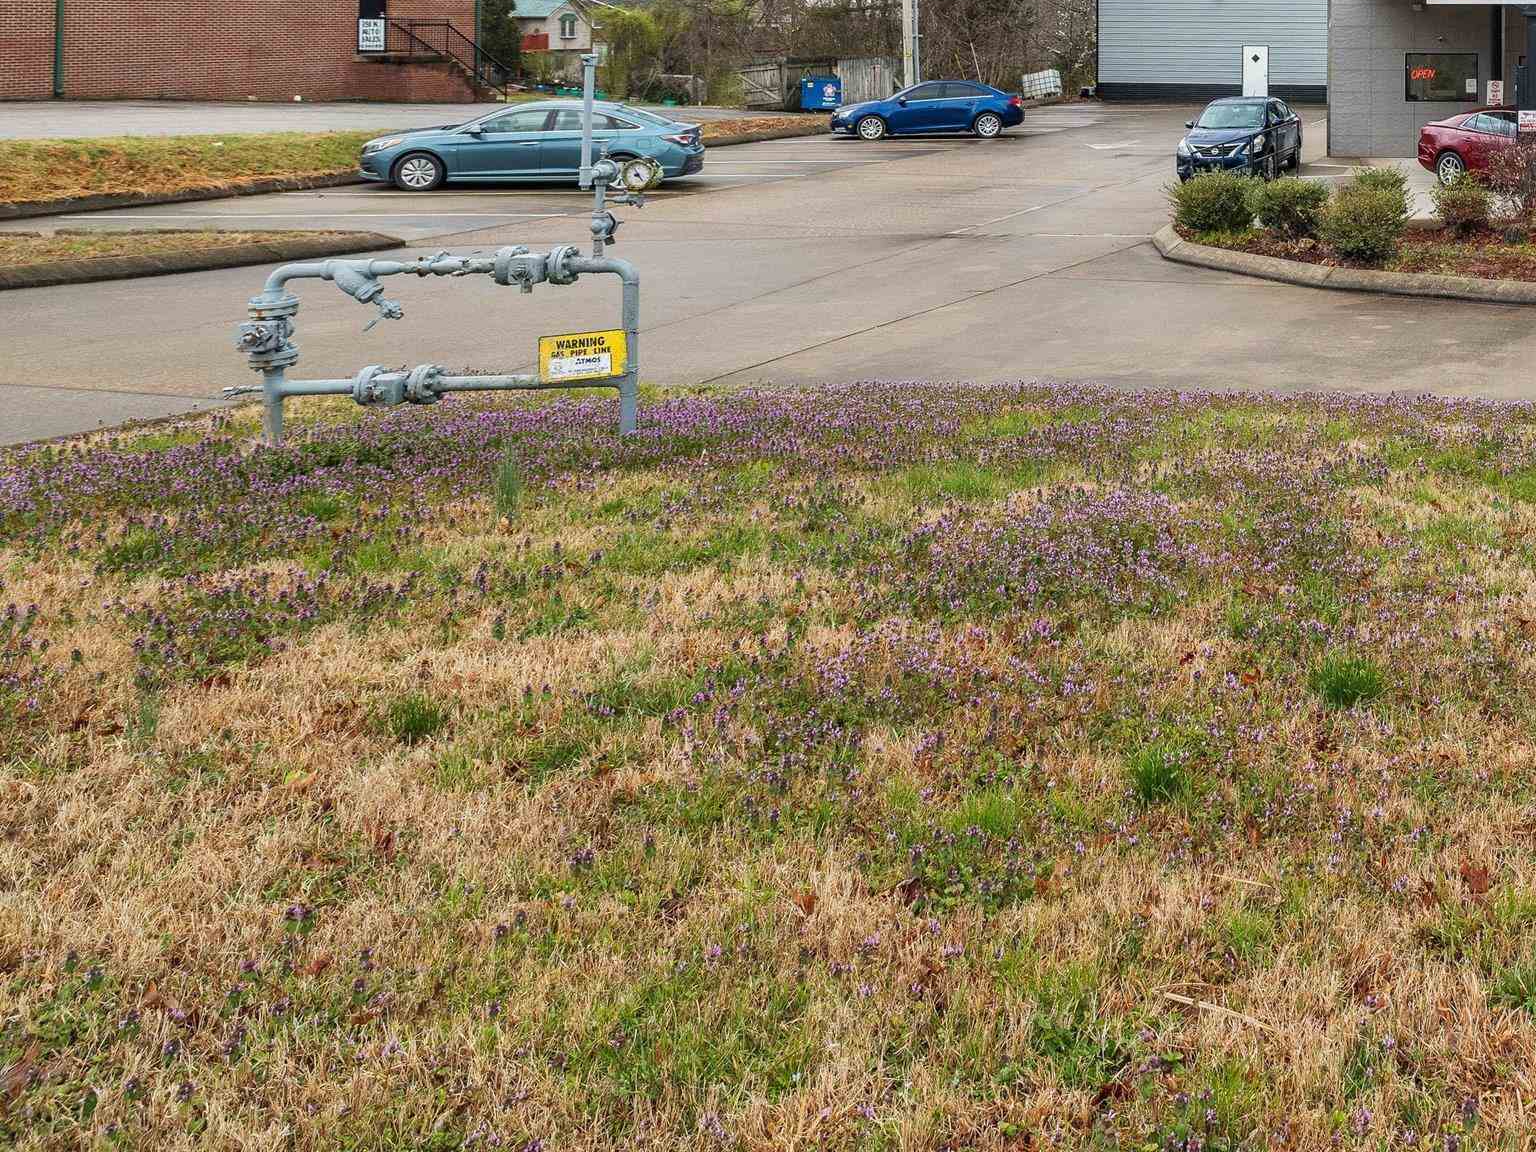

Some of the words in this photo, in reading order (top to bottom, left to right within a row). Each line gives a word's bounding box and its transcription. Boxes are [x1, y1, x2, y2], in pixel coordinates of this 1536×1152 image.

[1410, 68, 1436, 80] OPEN
[556, 336, 605, 349] WARNING
[570, 348, 588, 357] PIPE
[593, 346, 611, 354] LINE
[575, 357, 601, 365] ATMOS
